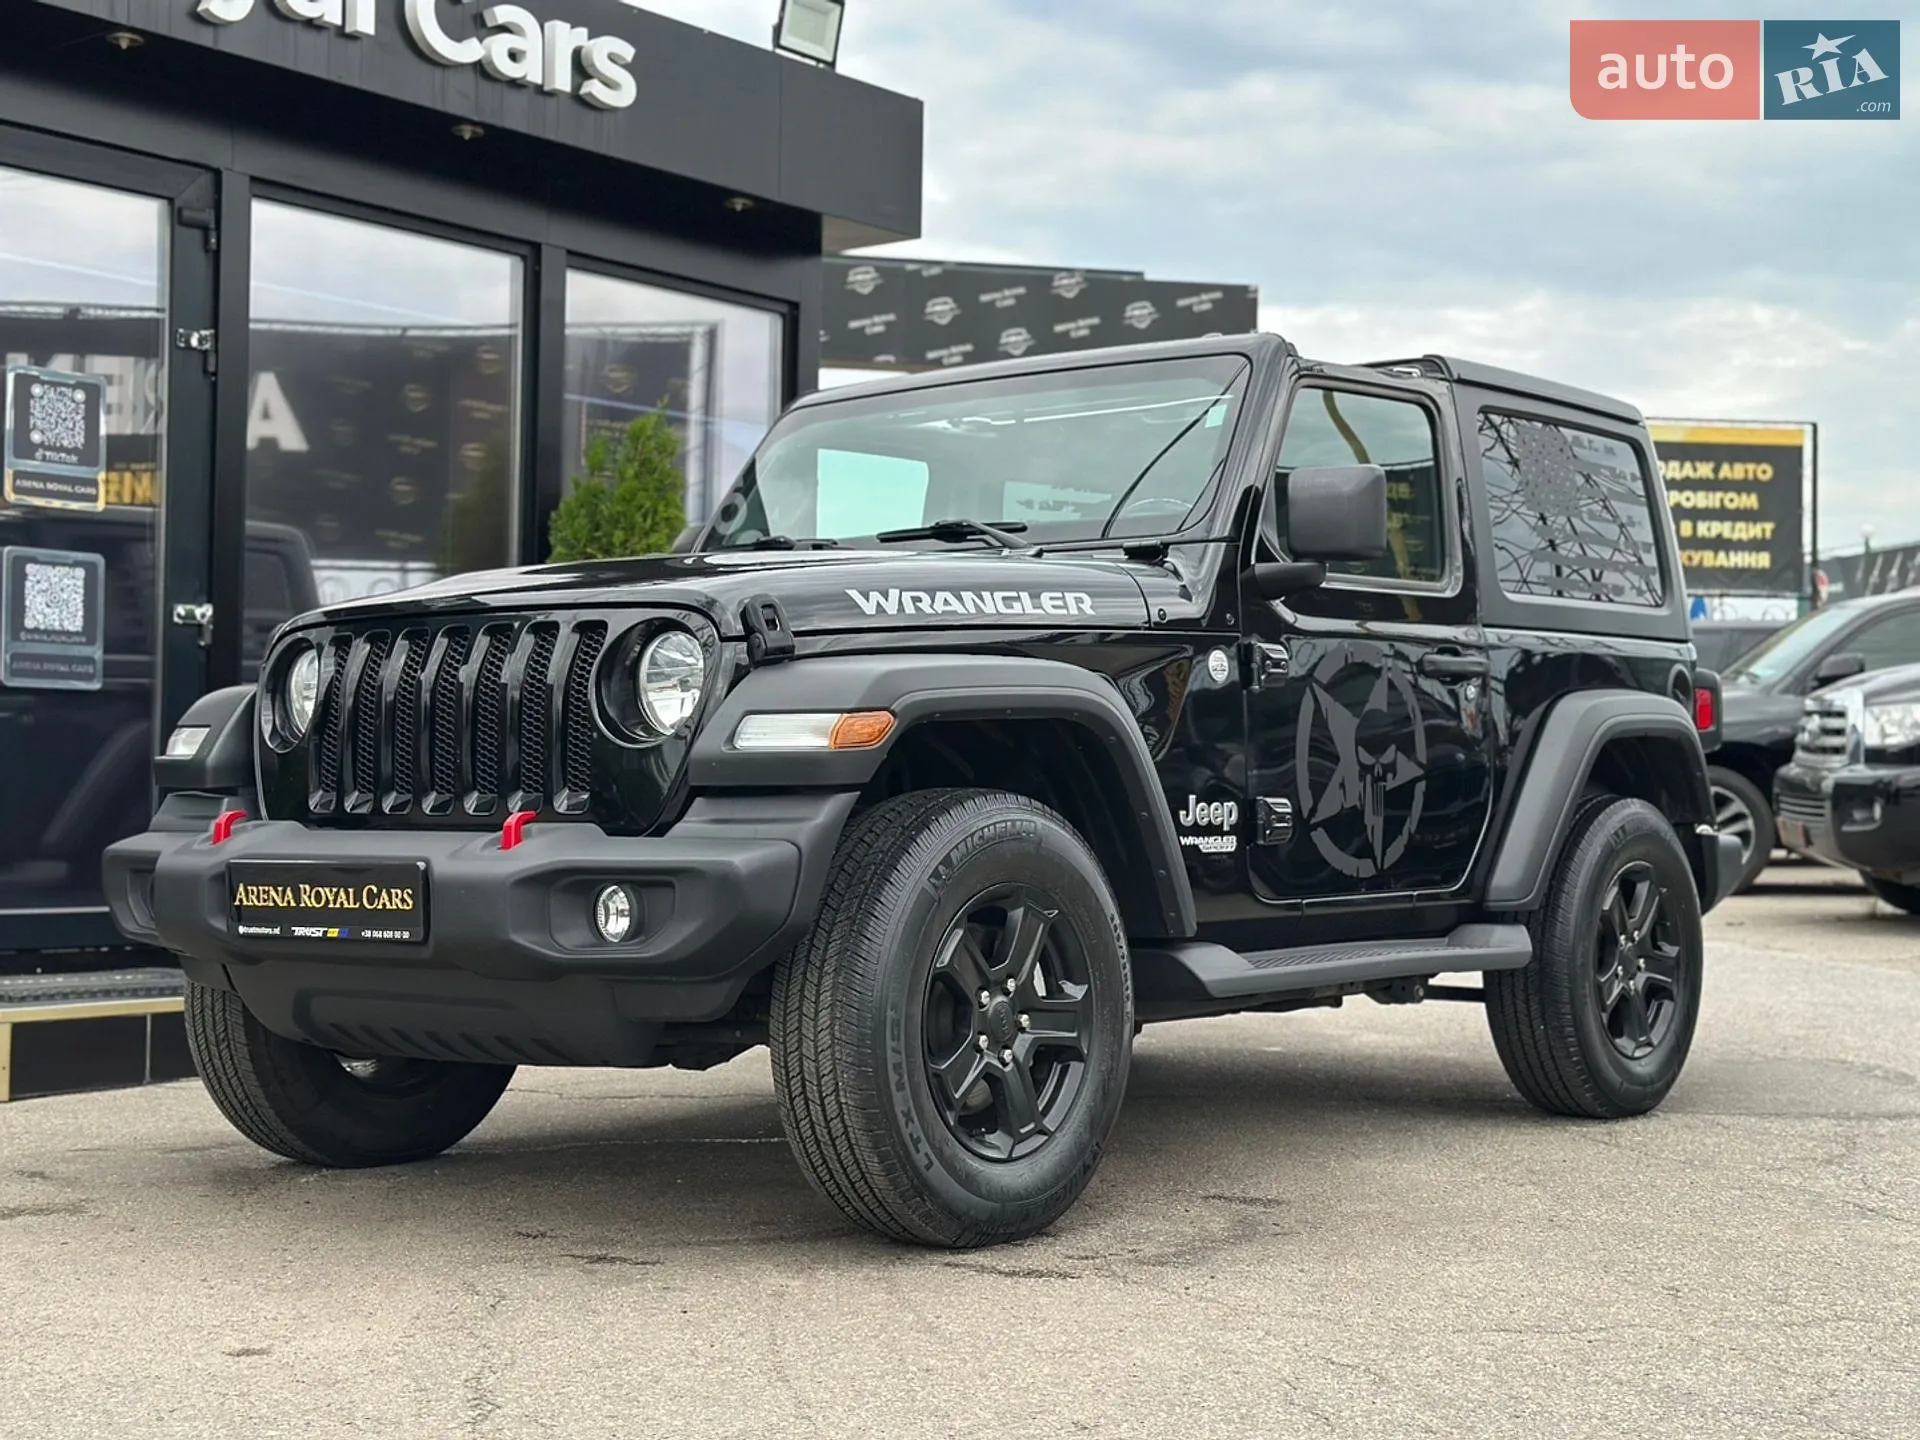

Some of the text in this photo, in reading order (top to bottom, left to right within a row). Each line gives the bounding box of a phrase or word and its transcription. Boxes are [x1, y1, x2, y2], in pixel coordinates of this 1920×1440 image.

[404, 0, 637, 110] Cars
[1719, 462, 1774, 482] АВТО
[1679, 519, 1775, 541] В КРЕДИТ
[844, 588, 1096, 616] WRANGLER
[1179, 794, 1239, 831] Jeep
[1179, 836, 1237, 847] WRANGLER
[234, 883, 414, 910] ARENA ROYAL CARS
[291, 926, 328, 938] TRUST
